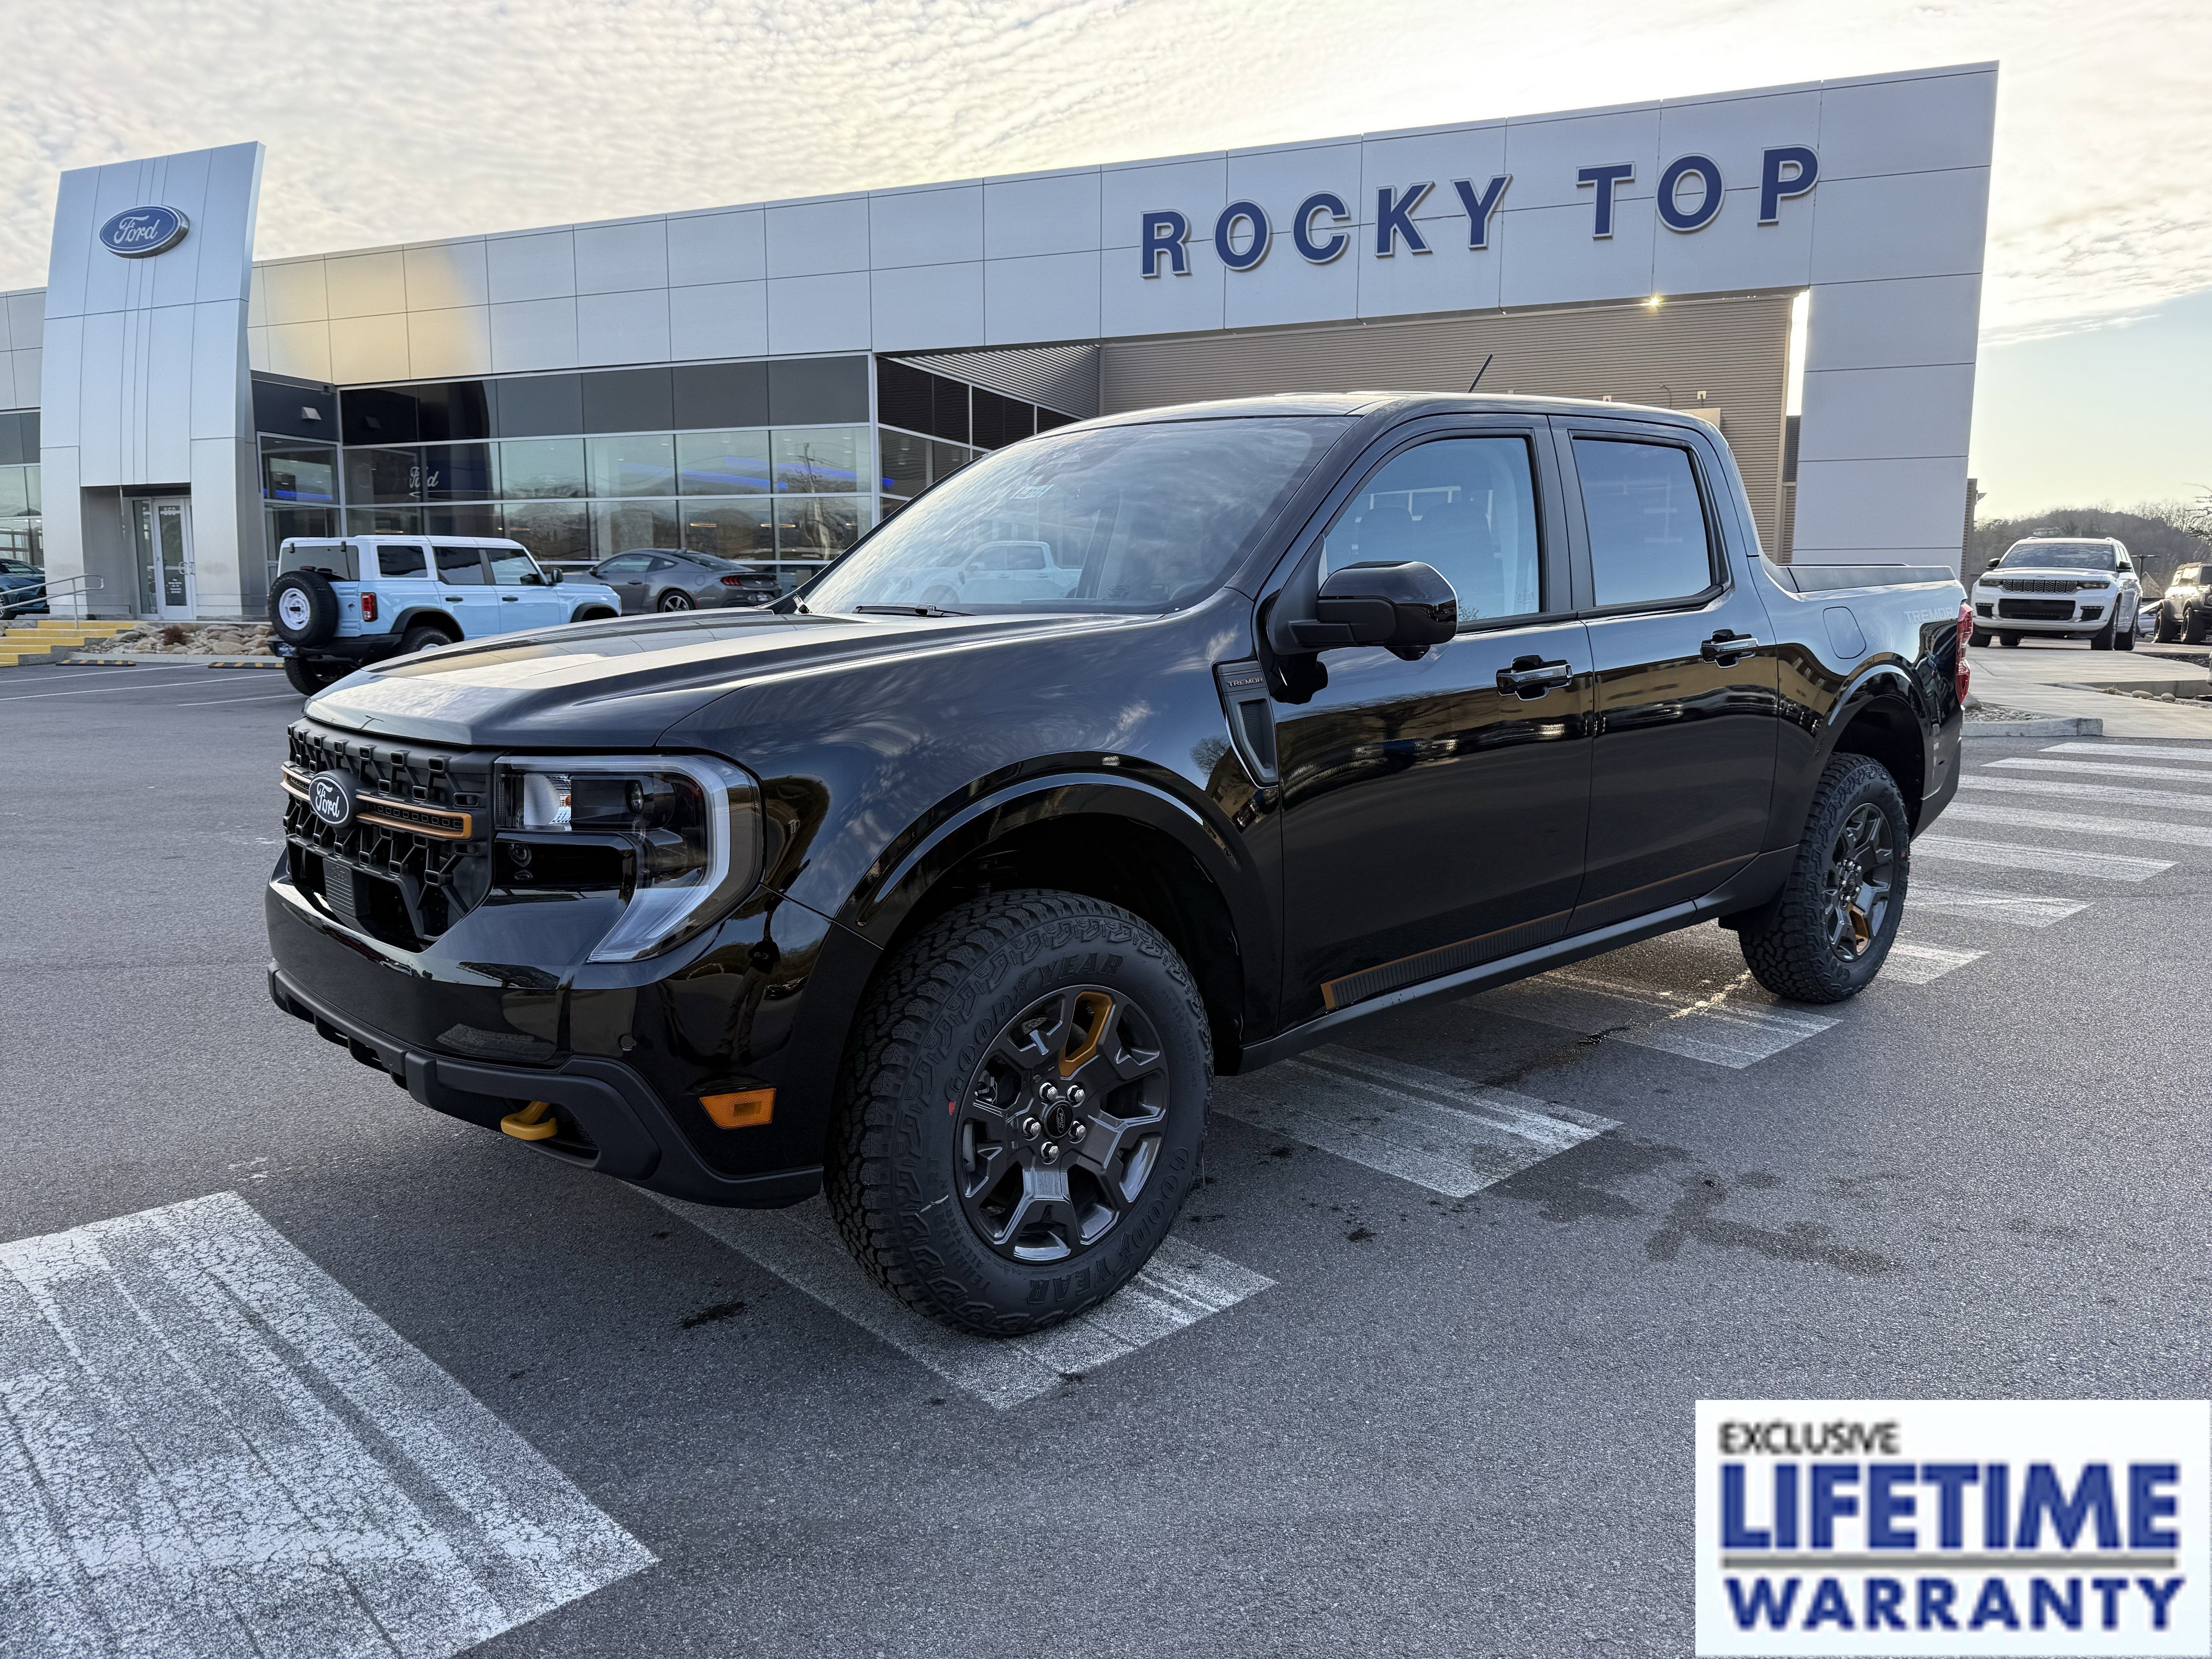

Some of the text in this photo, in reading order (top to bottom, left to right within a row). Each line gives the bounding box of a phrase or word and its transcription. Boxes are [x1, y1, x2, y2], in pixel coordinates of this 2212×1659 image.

[1140, 143, 1821, 280] ROCKY TOP
[113, 215, 160, 244] Ford
[1902, 606, 1955, 625] TREMOR
[1227, 677, 1263, 687] TREMOR
[315, 782, 339, 817] Ford
[927, 1195, 991, 1293] TERRITOR
